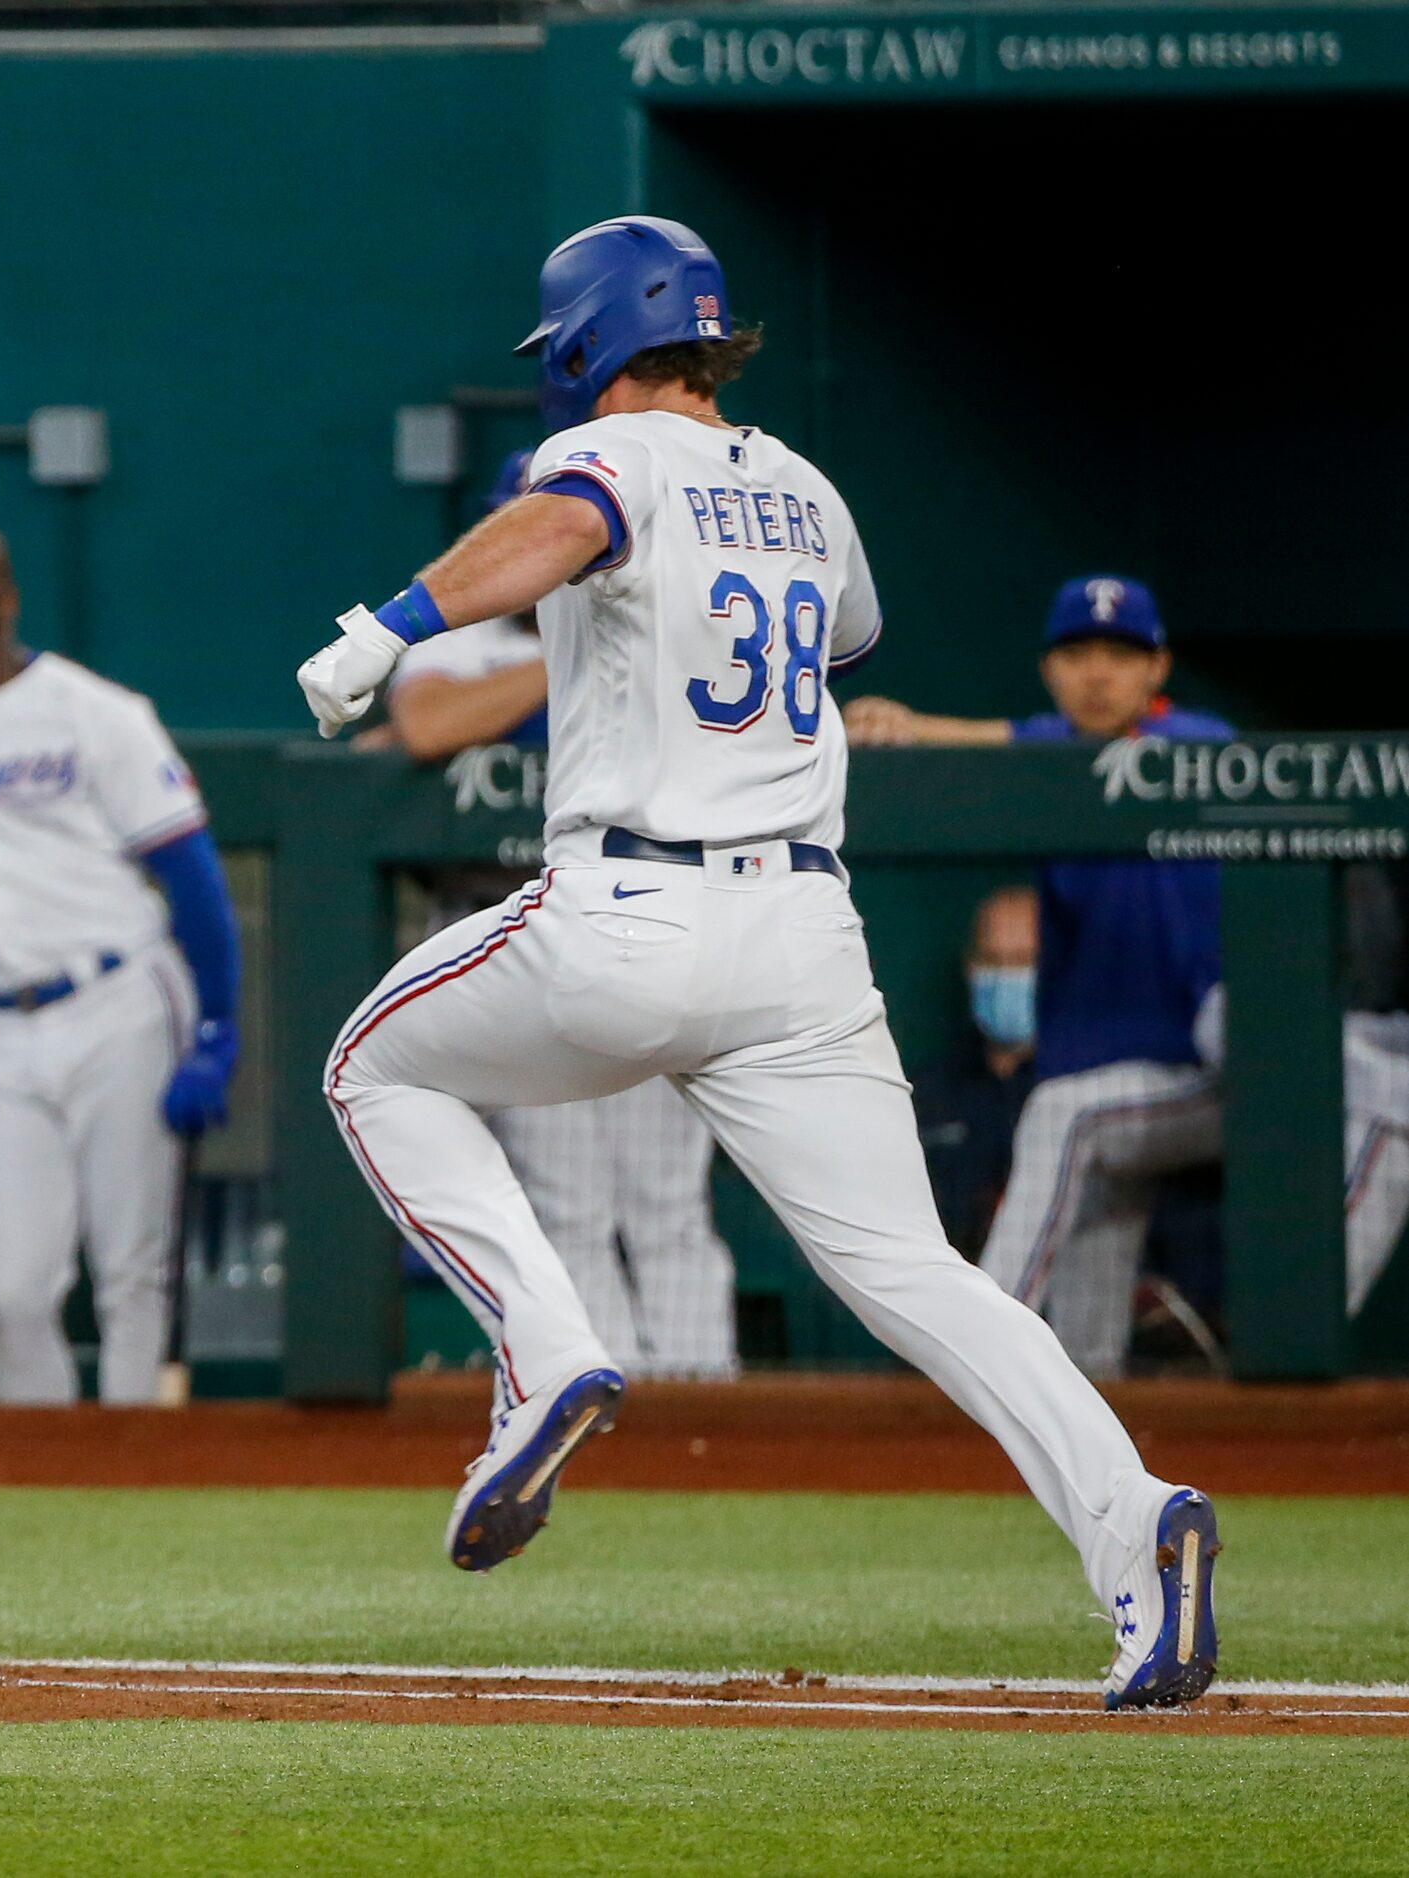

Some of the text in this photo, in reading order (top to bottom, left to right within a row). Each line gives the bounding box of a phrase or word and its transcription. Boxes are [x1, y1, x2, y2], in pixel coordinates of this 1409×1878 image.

[652, 21, 965, 84] CHOCTAW
[682, 487, 829, 562] PETERS
[1085, 579, 1125, 622] T
[686, 569, 828, 745] 38
